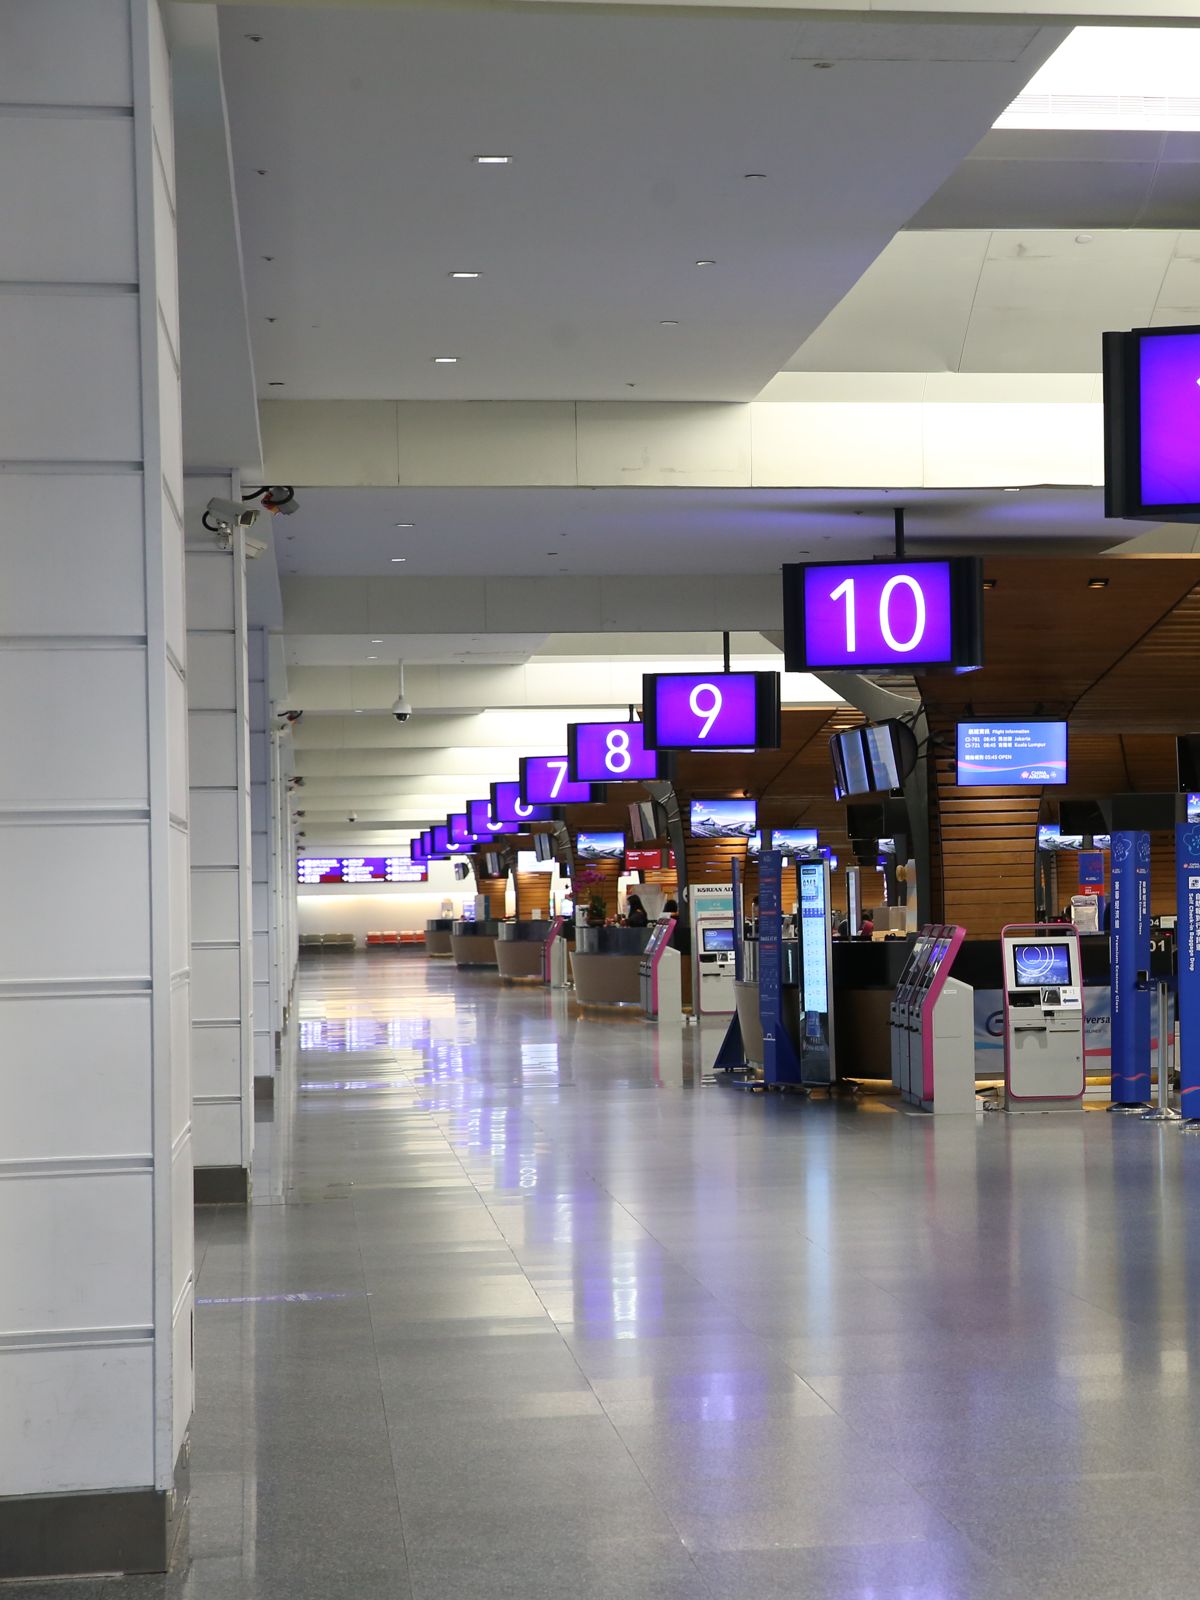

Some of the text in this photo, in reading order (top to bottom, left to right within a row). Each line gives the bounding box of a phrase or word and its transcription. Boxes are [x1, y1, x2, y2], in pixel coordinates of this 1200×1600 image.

[830, 574, 926, 652] 10
[689, 682, 722, 738] 9
[605, 729, 631, 772] 8
[547, 762, 568, 798] 7
[1150, 940, 1165, 951] 01
